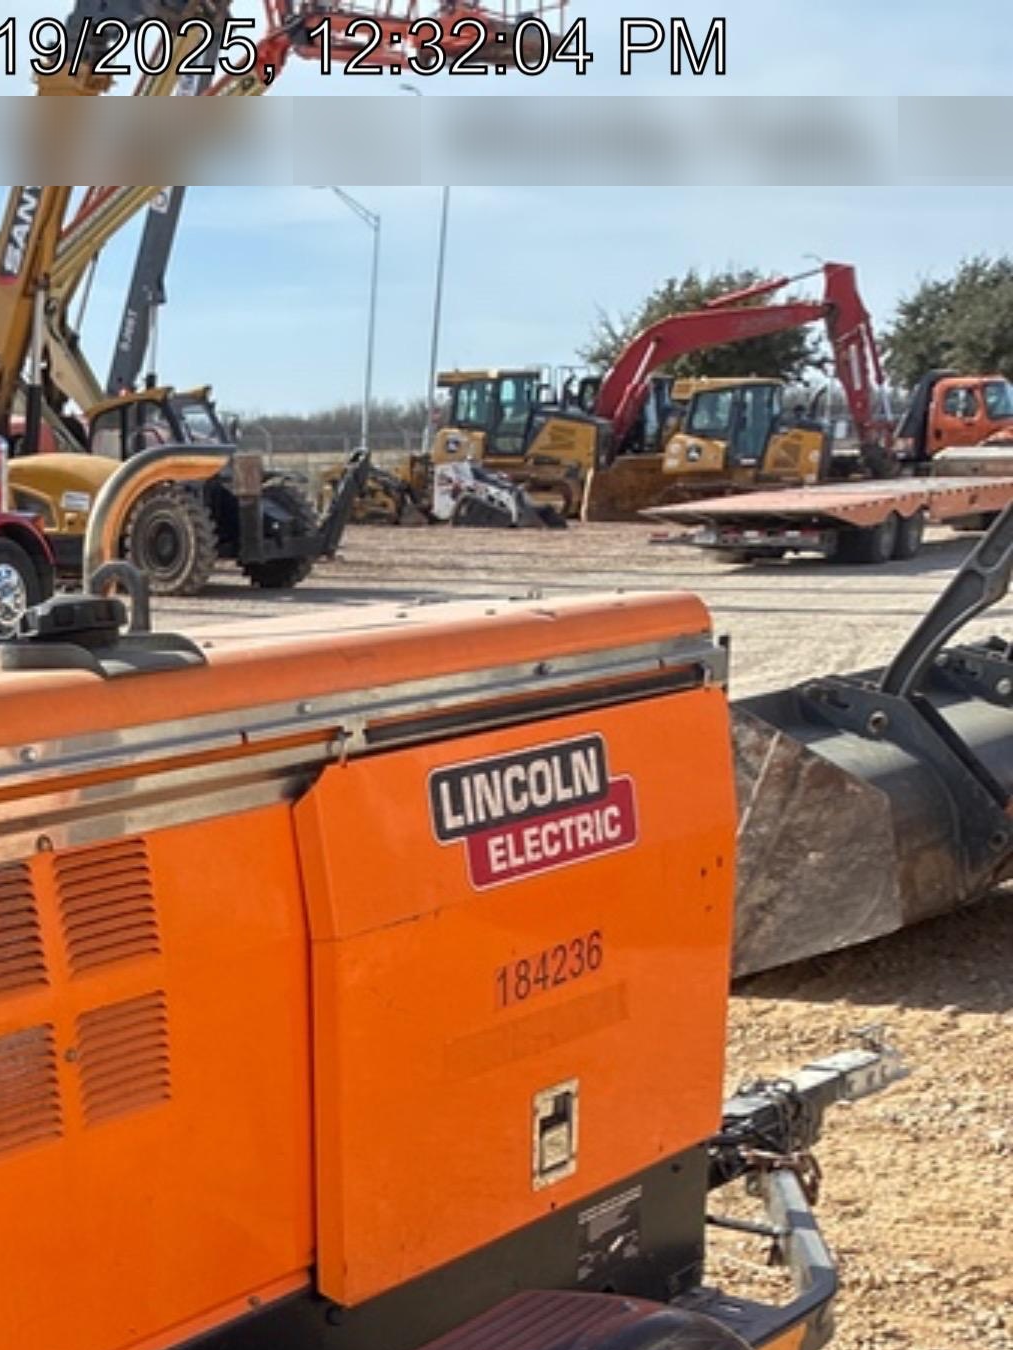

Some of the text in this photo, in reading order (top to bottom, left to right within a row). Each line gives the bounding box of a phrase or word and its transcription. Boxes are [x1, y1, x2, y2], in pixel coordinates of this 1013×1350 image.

[439, 747, 601, 830] LINCOLN
[486, 805, 622, 874] ELECTRIC
[496, 929, 604, 1008] 184236
